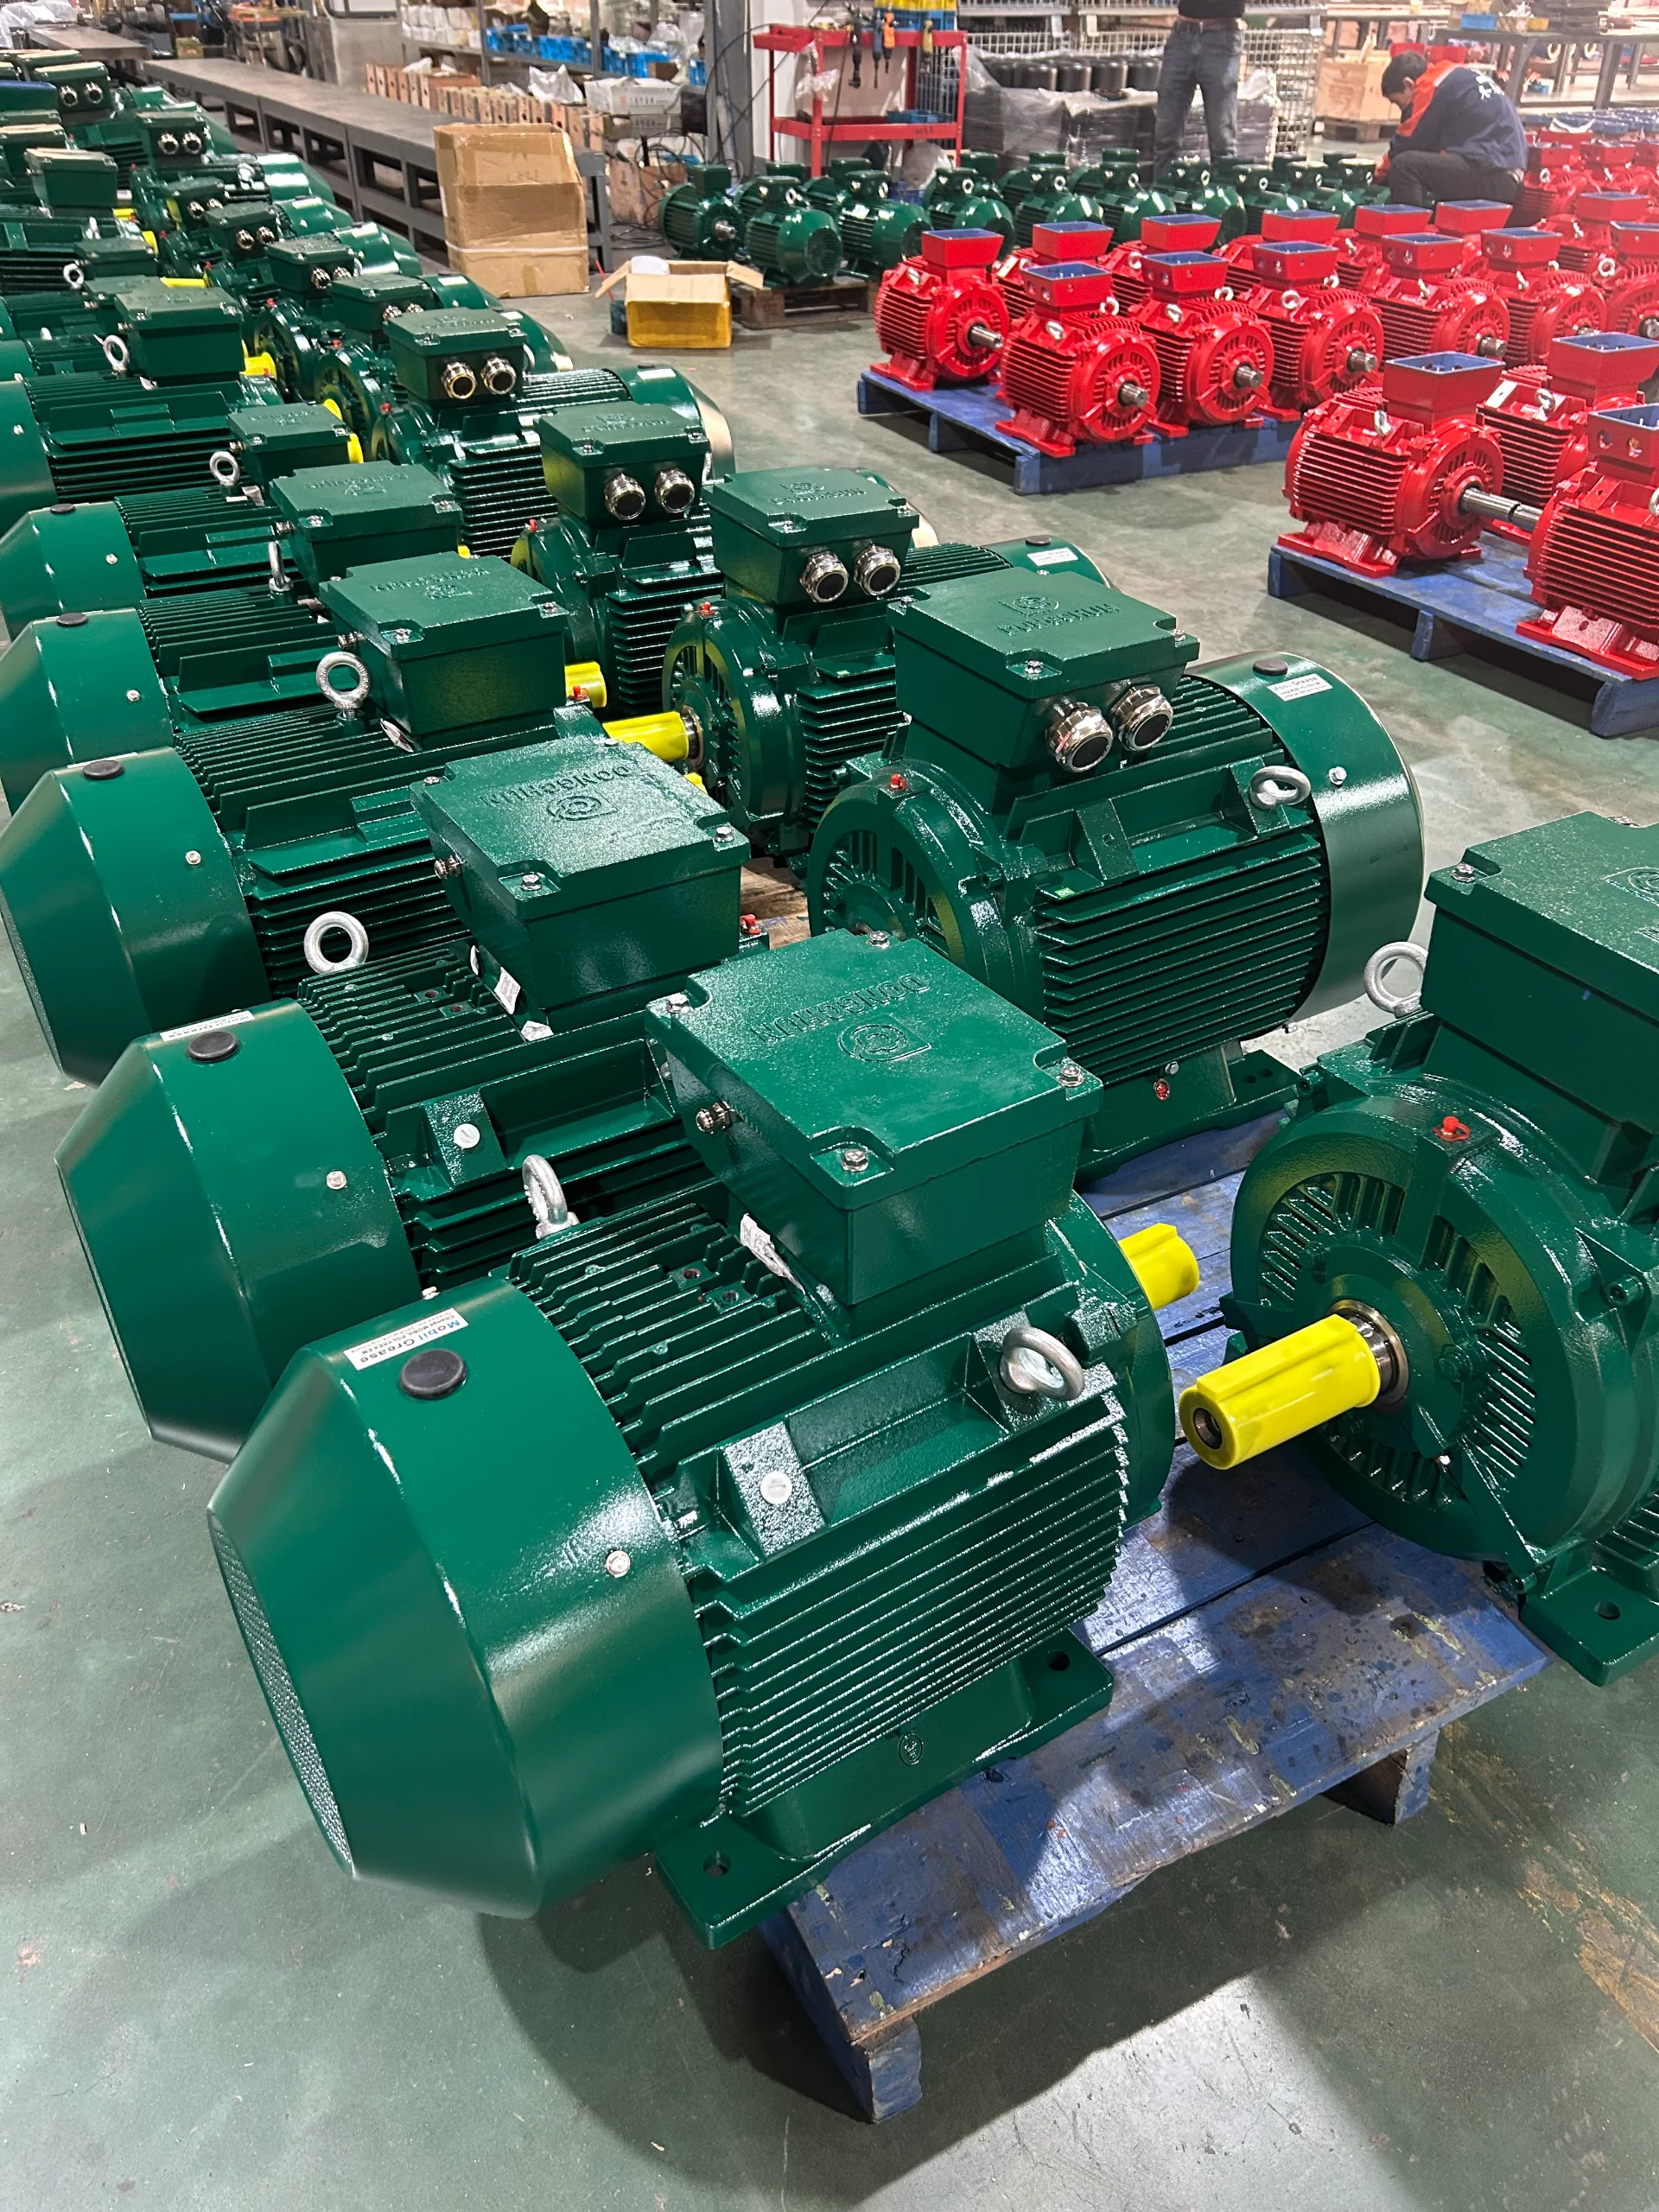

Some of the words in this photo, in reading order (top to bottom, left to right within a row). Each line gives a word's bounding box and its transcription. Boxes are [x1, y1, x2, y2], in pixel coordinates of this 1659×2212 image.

[750, 973, 931, 1044] DONGCHUN
[406, 1325, 429, 1336] MOBIL
[418, 1319, 461, 1340] Mobil
[360, 1339, 415, 1363] Grease
